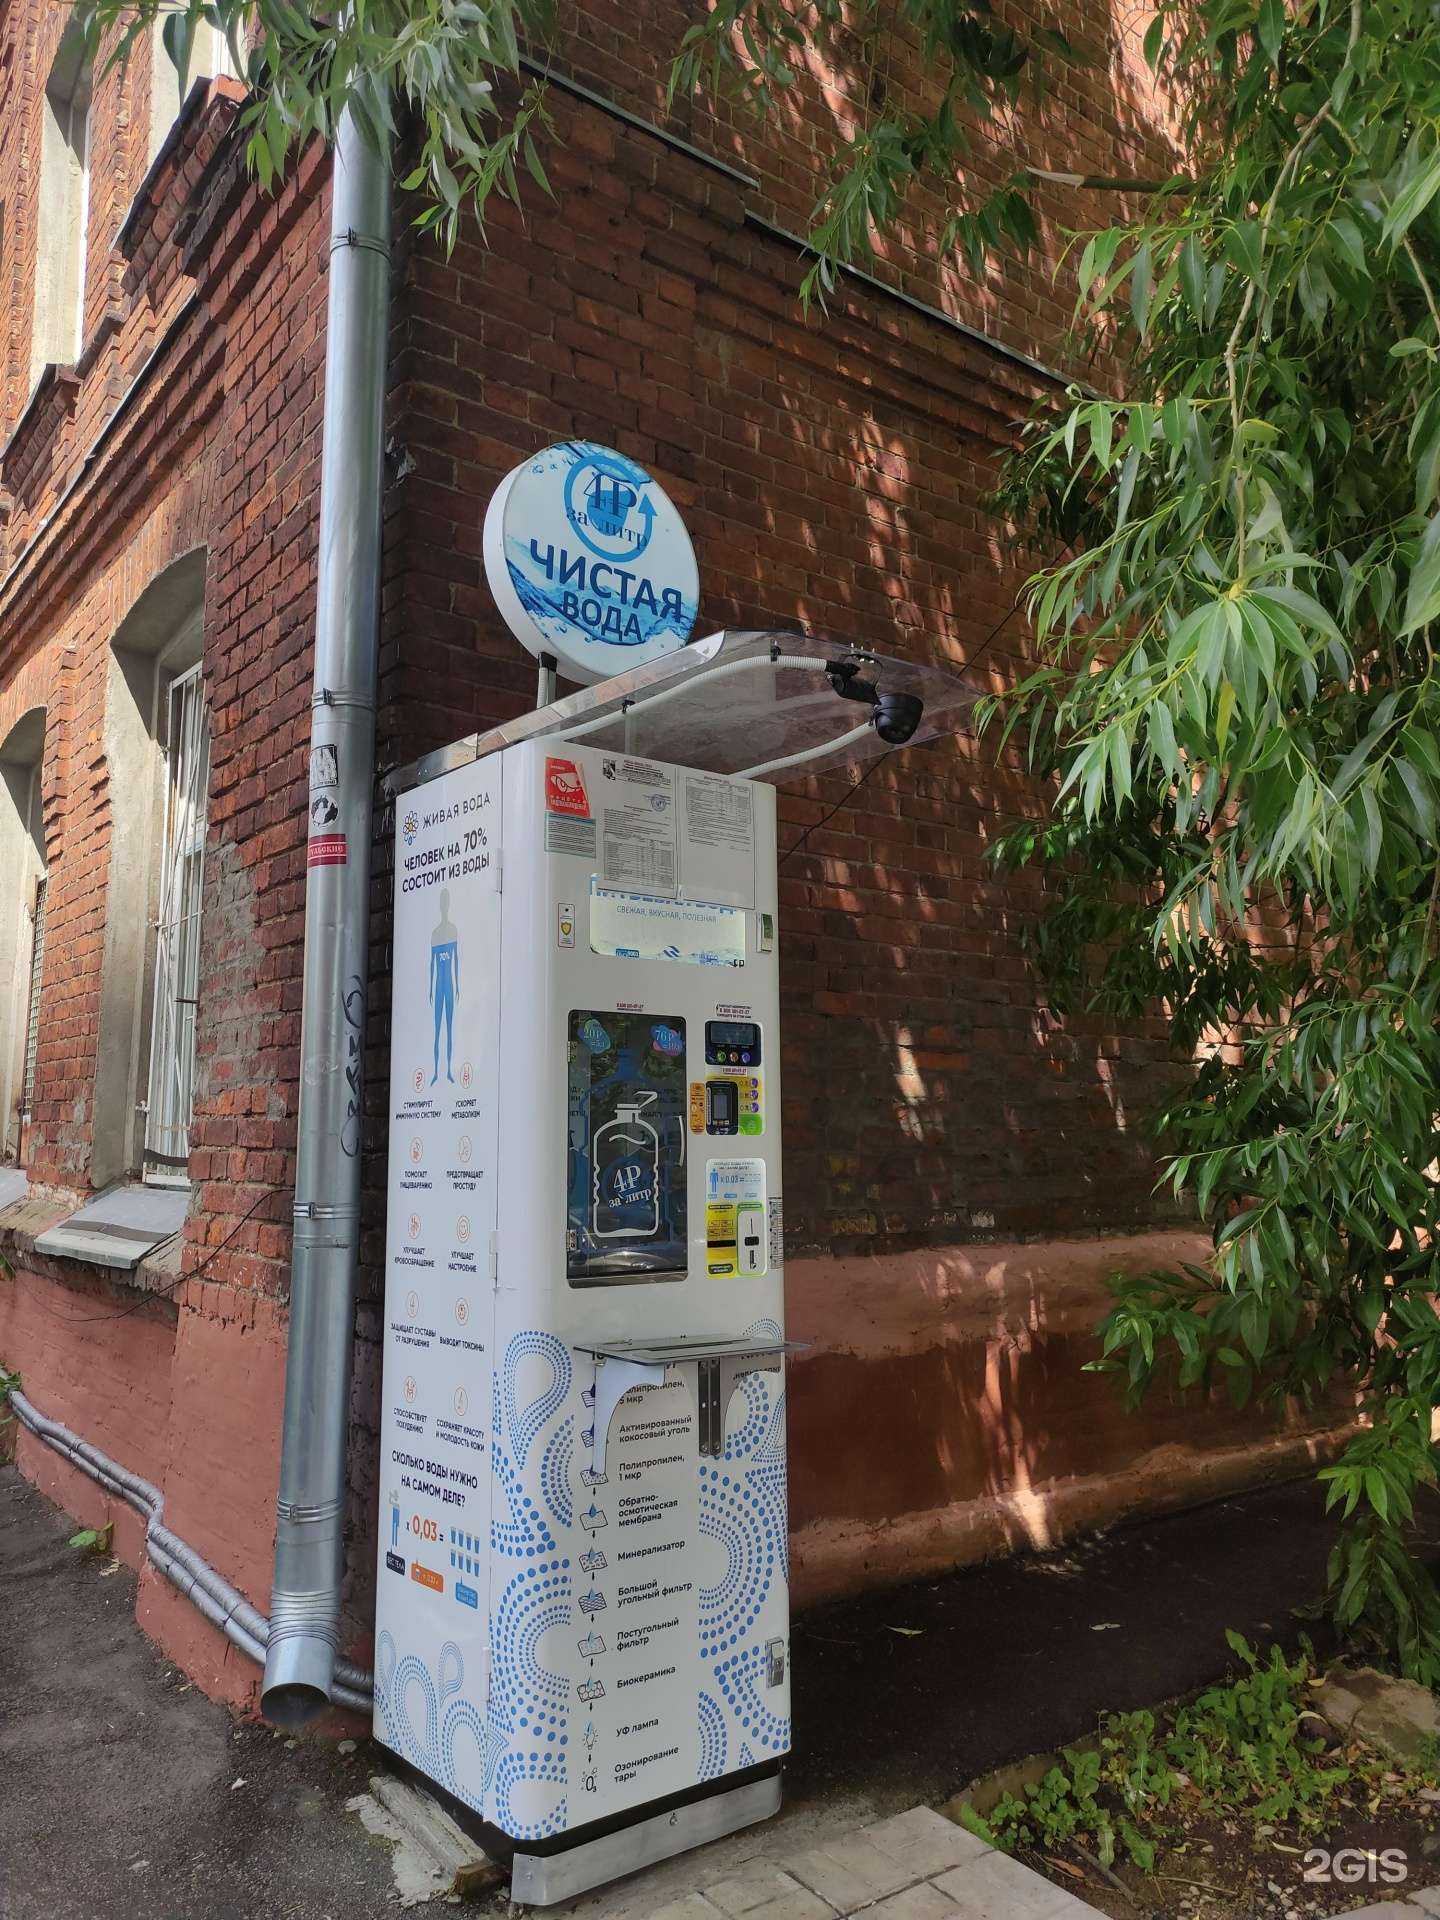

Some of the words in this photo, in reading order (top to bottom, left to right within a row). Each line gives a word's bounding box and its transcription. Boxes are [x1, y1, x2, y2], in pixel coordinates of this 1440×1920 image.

[566, 506, 589, 527] за
[530, 538, 682, 623] ЧИСТАЯ
[562, 591, 642, 641] ВОДА
[423, 804, 459, 829] ЖИВАЯ
[463, 792, 491, 814] ВОДА
[404, 846, 445, 871] ЧЕЛОВЕК
[447, 842, 461, 859] НА
[463, 827, 488, 852] 70%
[402, 866, 447, 893] СОСТОИТ
[448, 862, 461, 879] ИЗ
[462, 852, 490, 876] ВОДЫ
[403, 1100, 433, 1109] СТИМУЛИРУЕТ
[455, 1098, 477, 1108] УСКОРЯЕТ
[421, 1111, 442, 1119] СИСТЕМУ
[404, 1171, 427, 1179] ПОМОГАЕТ
[446, 1170, 484, 1179] ПРЕДОТВРАЩАЕТ
[400, 1181, 432, 1190] ПИЩЕВАРЕНИЮ
[453, 1182, 477, 1191] ПРОСТУДУ
[608, 1197, 622, 1208] за
[625, 1188, 652, 1204] литр
[402, 1246, 425, 1255] УЛУЧШАЕТ
[451, 1251, 474, 1260] УЛУЧШАЕТ
[394, 1256, 435, 1268] КРОВООБРАЩЕНИЕ
[448, 1262, 477, 1273] НАСТРОЕНИЕ
[414, 1326, 436, 1337] СУСТАВЫ
[440, 1336, 461, 1347] ВЫВОДИТ
[462, 1340, 485, 1352] ТОКСИНЫ
[626, 1395, 644, 1404] мкр
[393, 1407, 428, 1423] СПОСОБСТВУЕТ
[396, 1420, 424, 1434] ПОХУДЕНИЮ
[436, 1418, 463, 1433] СОХРАНЯЕТ
[463, 1425, 484, 1439] КРАСОТУ
[619, 1414, 692, 1434] Активированный
[440, 1433, 469, 1449] МОЛОДОСТЬ
[470, 1442, 485, 1453] КОЖИ
[619, 1430, 666, 1443] кокосовый
[667, 1426, 690, 1438] уголь
[391, 1450, 425, 1472] СКОЛЬКО
[426, 1460, 449, 1480] ВОДЫ
[449, 1468, 478, 1489] НУЖНО
[619, 1454, 685, 1471] Полипропилен,
[624, 1471, 642, 1480] мкр
[401, 1474, 412, 1489] НА
[412, 1478, 441, 1500] САМОМ
[442, 1489, 466, 1508] ДЕЛЕ?
[618, 1494, 659, 1508] Обратно-
[618, 1500, 678, 1518] осмотическая
[412, 1515, 438, 1542] 0,03
[618, 1512, 662, 1528] мембрана
[617, 1540, 686, 1562] Минерализатор
[617, 1589, 660, 1608] угольный
[661, 1582, 693, 1597] фильтр
[618, 1579, 658, 1596] Большой
[617, 1617, 679, 1641] Постугольный
[616, 1637, 650, 1652] фильтр
[616, 1666, 676, 1689] Биокерамика
[615, 1725, 630, 1738] УФ
[632, 1718, 659, 1734] лампа
[614, 1746, 679, 1774] Озонирование
[613, 1771, 637, 1784] тары
